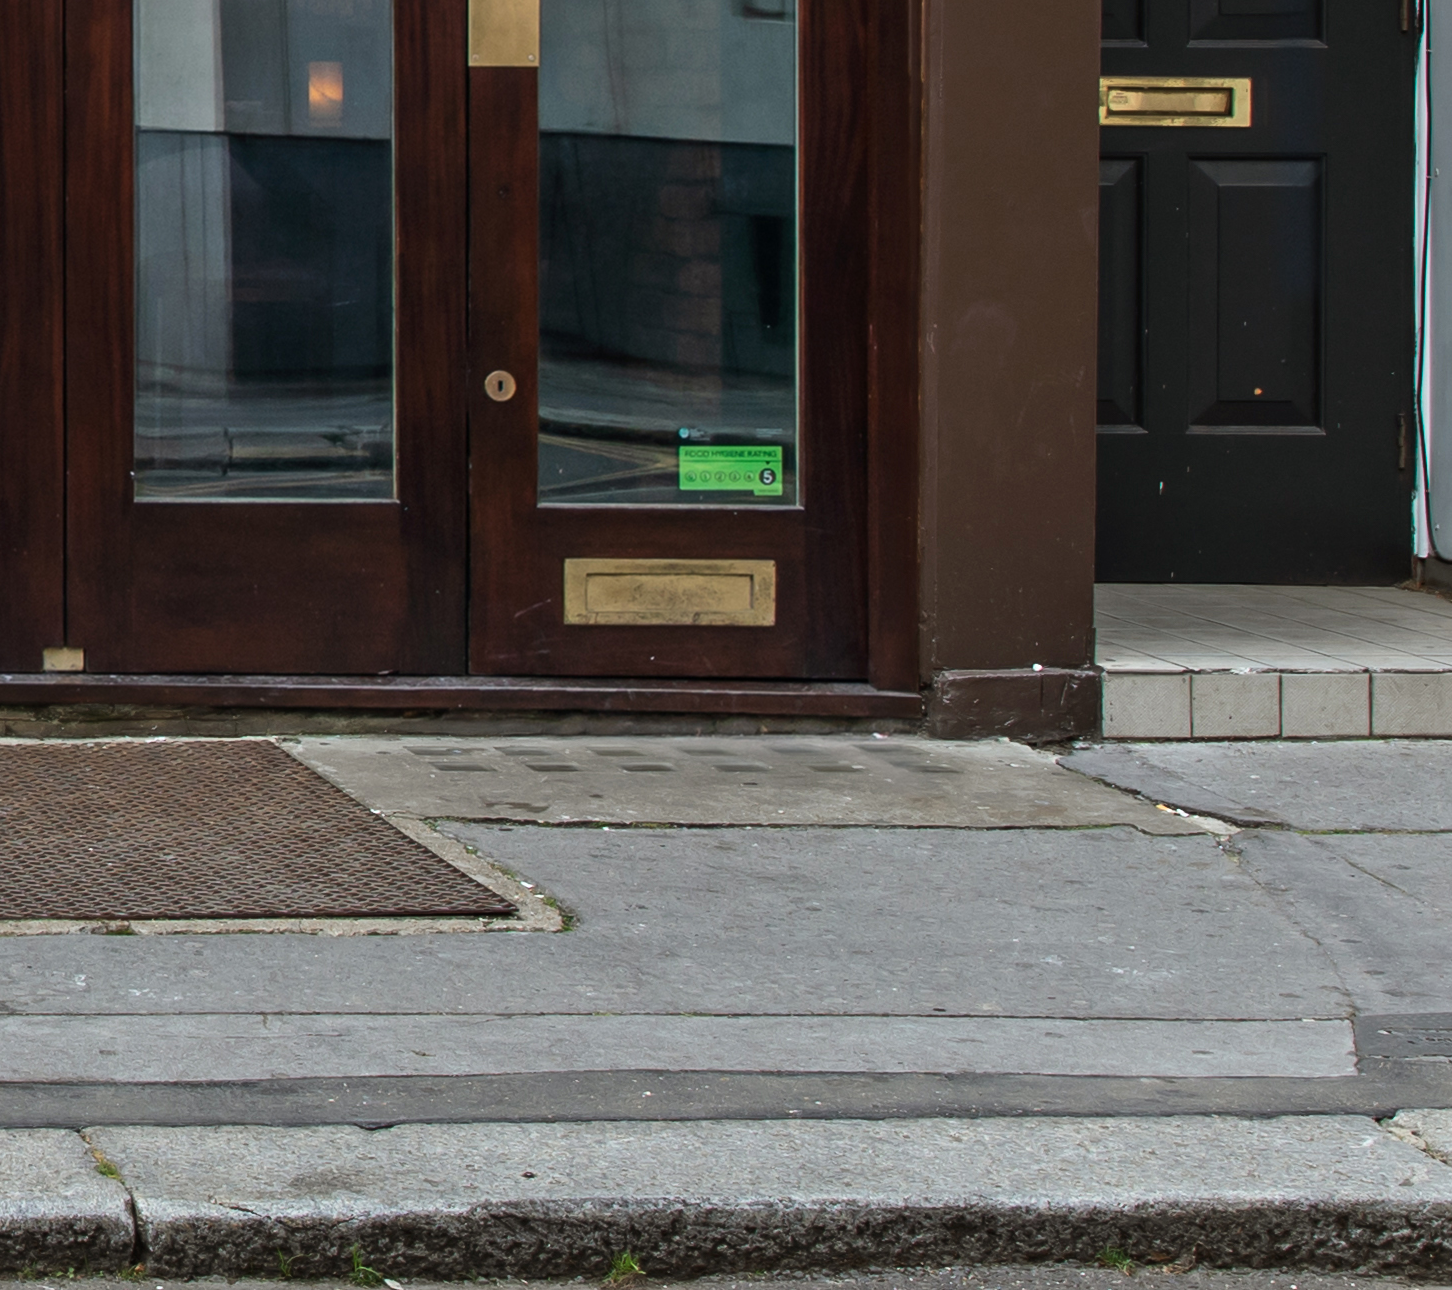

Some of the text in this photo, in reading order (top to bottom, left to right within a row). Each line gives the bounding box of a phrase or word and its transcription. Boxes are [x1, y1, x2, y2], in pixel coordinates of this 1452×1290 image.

[711, 450, 745, 458] HYGIENE
[747, 450, 777, 458] RATING
[762, 470, 773, 484] 5
